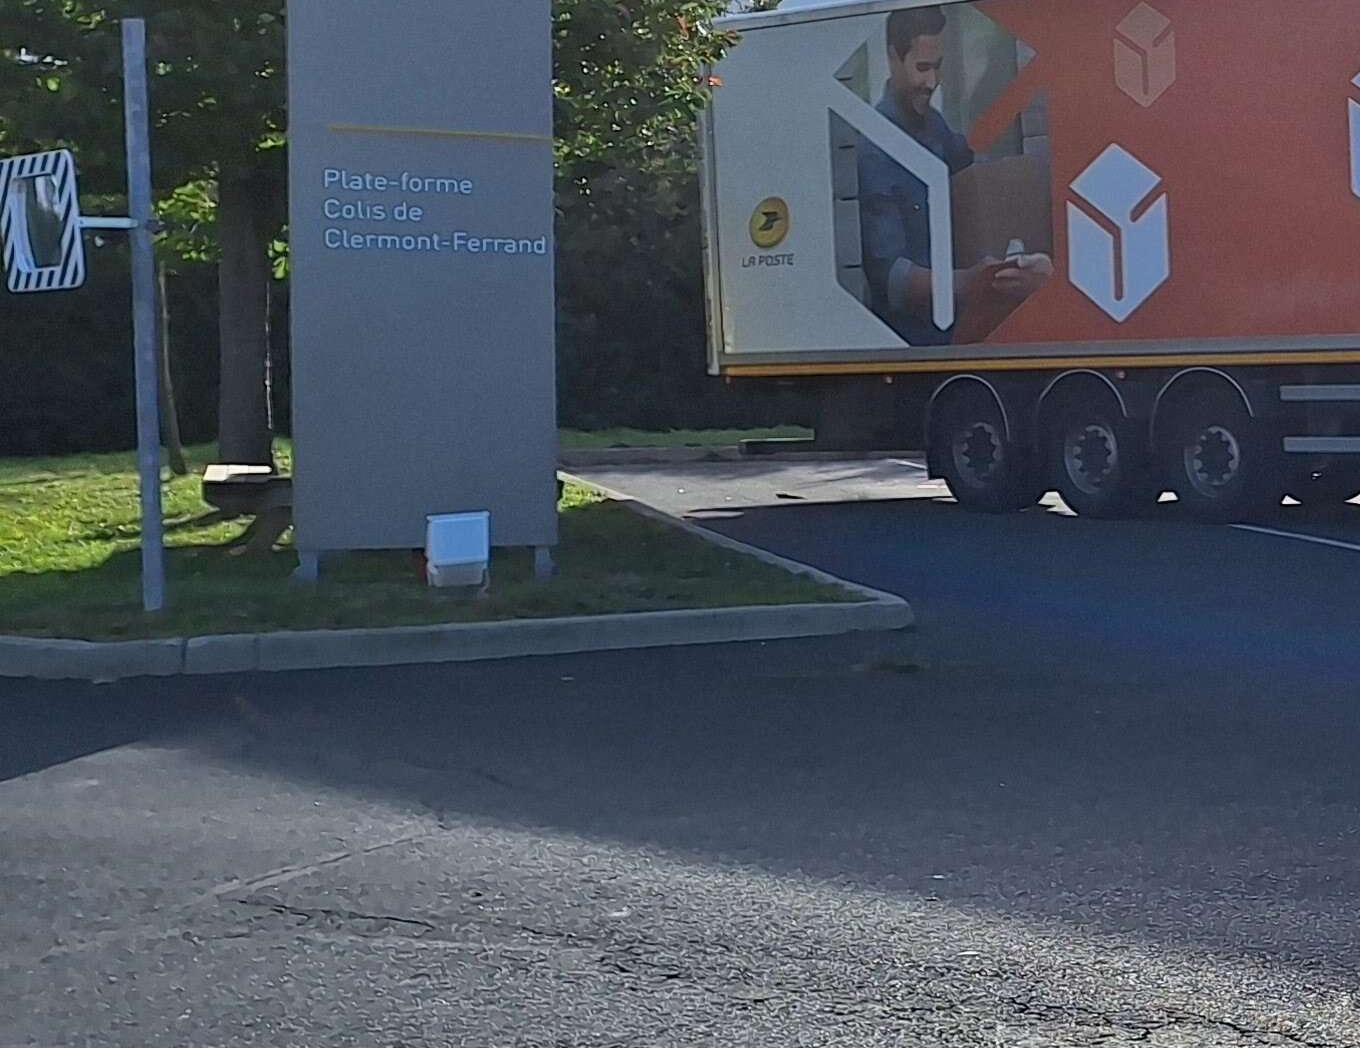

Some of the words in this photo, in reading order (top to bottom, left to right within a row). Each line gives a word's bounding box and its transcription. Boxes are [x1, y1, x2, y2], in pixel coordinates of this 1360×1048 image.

[323, 168, 473, 194] Plate-forme
[324, 199, 386, 219] Colis
[394, 202, 423, 221] de
[325, 229, 547, 254] Clermont-Ferrand
[742, 256, 756, 268] LA
[759, 253, 795, 266] POSTE
